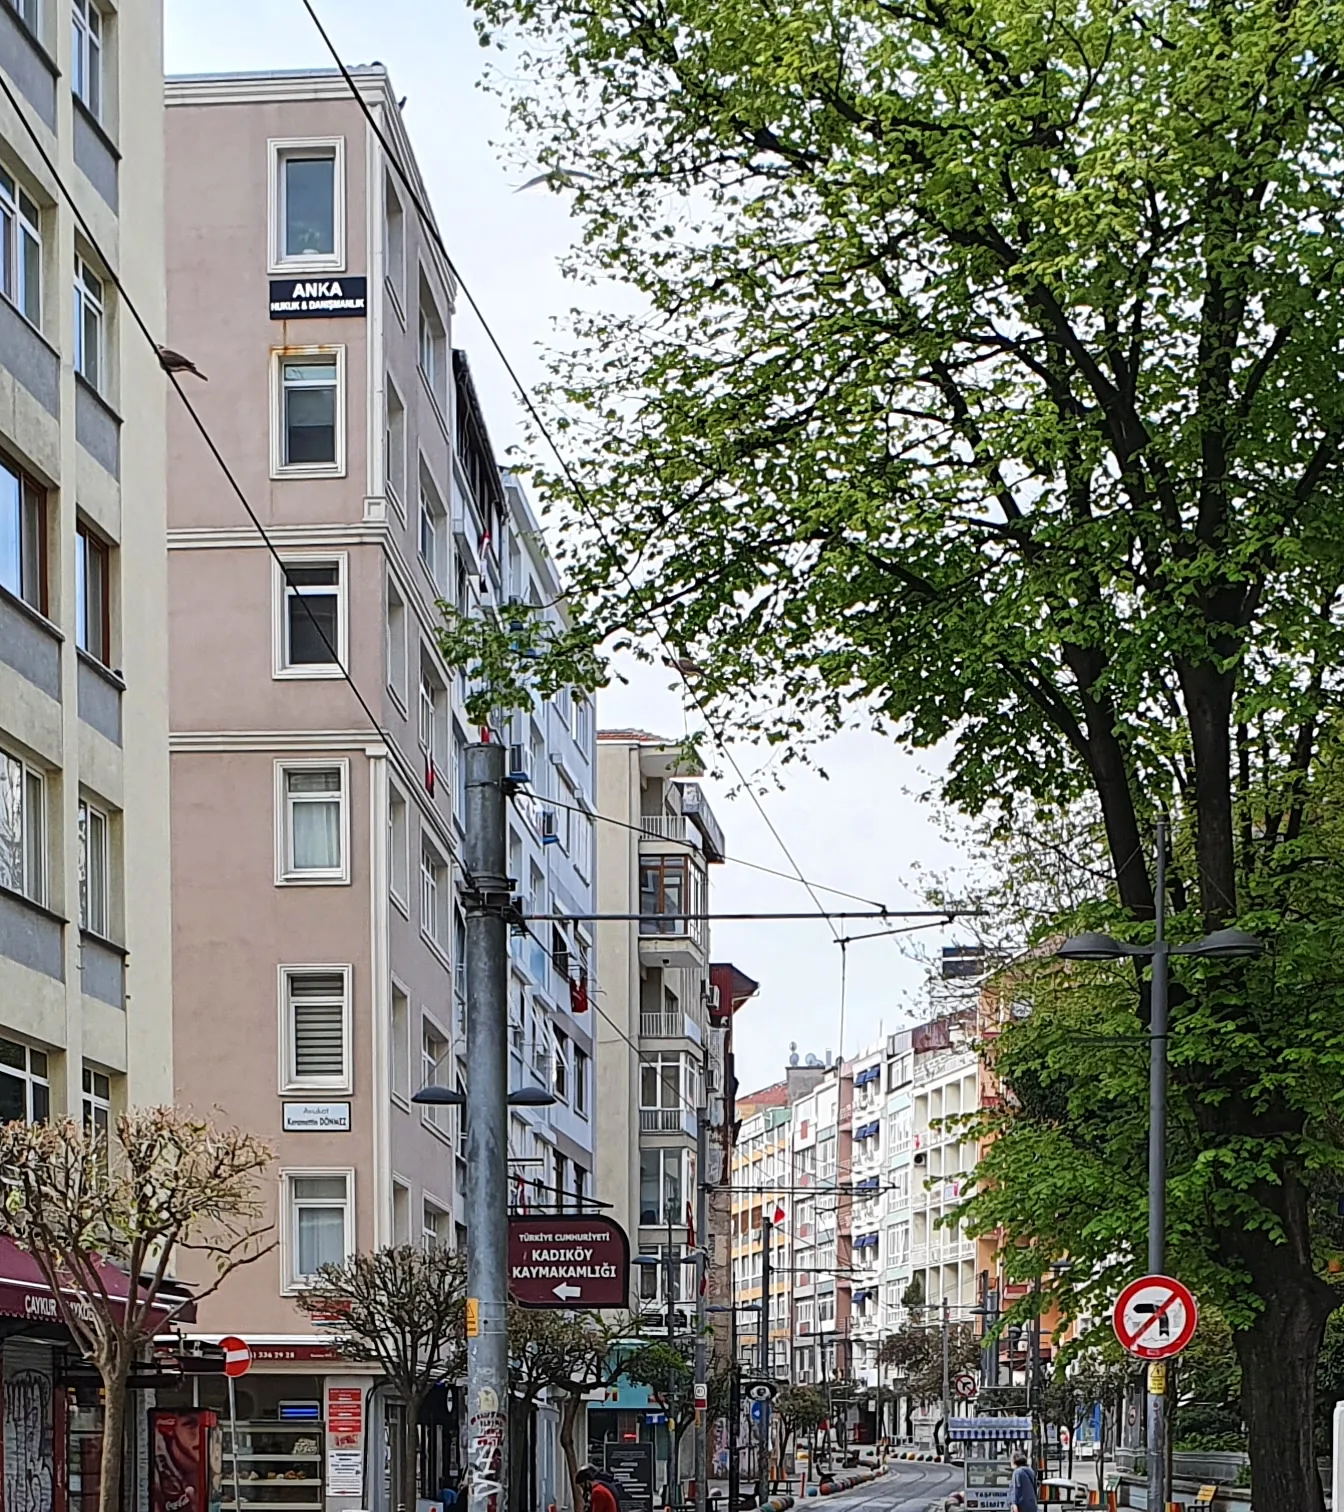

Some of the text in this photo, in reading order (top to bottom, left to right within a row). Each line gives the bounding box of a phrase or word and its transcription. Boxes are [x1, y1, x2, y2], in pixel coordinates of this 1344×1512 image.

[292, 282, 343, 298] ANKA
[270, 301, 301, 311] HUKUK
[309, 298, 365, 311] DANIŞMANLIK
[519, 1231, 610, 1242] TÜRKİYE CUMHURİYETİ
[532, 1245, 593, 1261] KADIKÖY
[512, 1262, 617, 1278] KAYMAKAMLIĞI
[980, 1500, 1006, 1508] SİMİT
